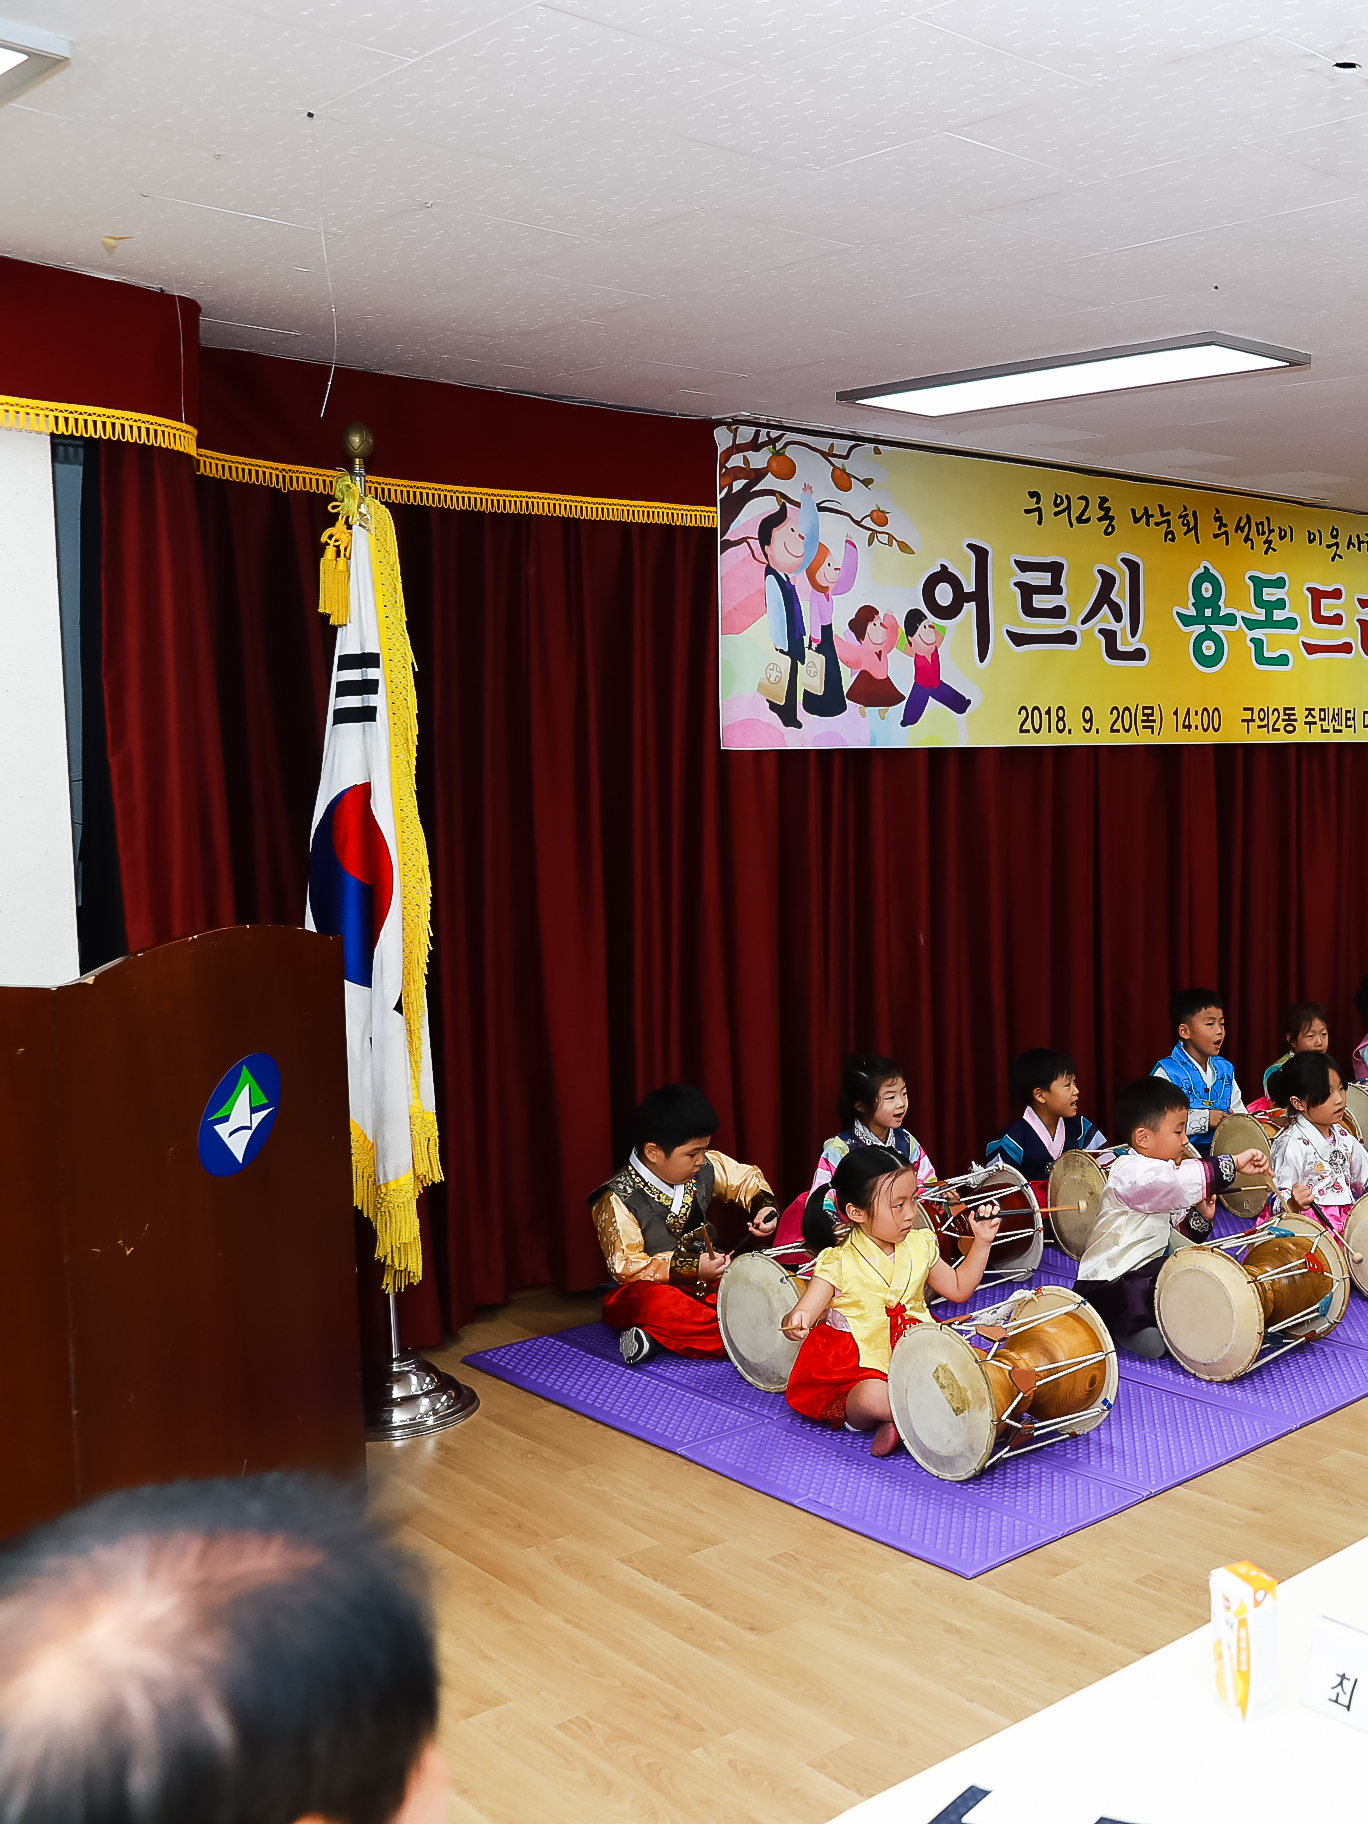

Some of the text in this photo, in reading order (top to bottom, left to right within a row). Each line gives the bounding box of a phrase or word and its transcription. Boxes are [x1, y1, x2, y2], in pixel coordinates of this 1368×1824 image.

[1023, 490, 1116, 537] 구의2동
[1130, 503, 1201, 545] 나눔회
[1212, 506, 1294, 556] 추석맞이
[919, 541, 1149, 664] 어르신
[1017, 705, 1072, 735] 2018.
[1081, 705, 1100, 735] 9.
[1109, 703, 1164, 737] 20(목)
[1172, 706, 1222, 733] 14:00
[1241, 706, 1298, 735] 구의2동
[1303, 706, 1357, 734] 주민센터
